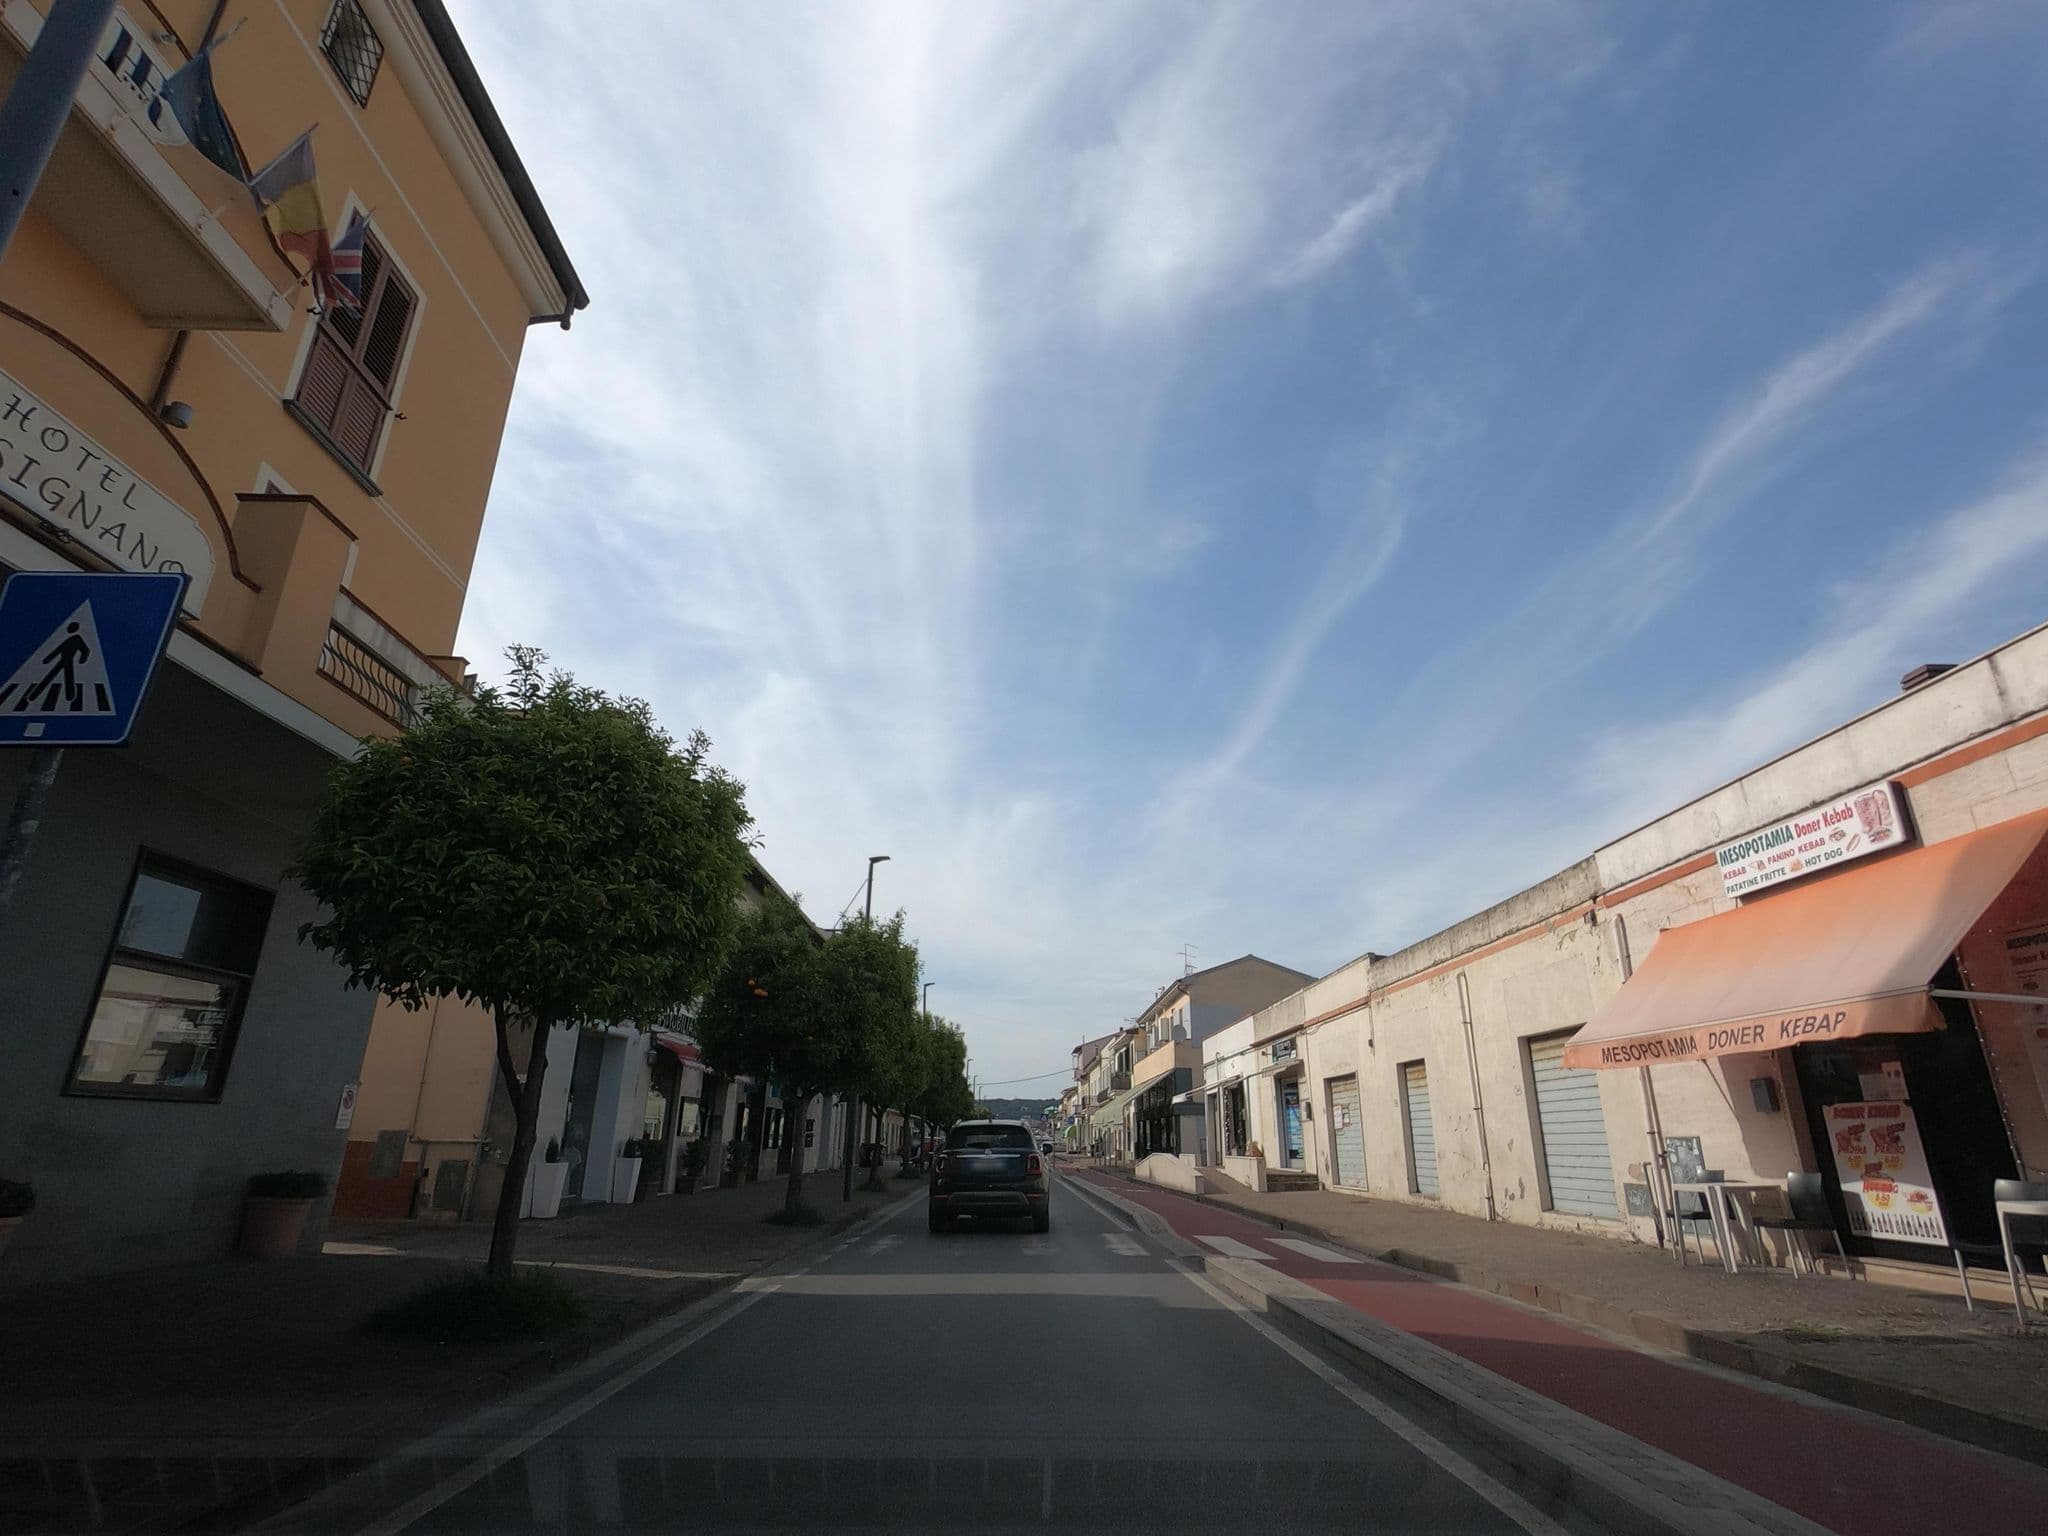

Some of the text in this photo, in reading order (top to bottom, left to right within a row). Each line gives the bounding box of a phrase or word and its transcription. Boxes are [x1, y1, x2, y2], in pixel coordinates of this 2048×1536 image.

[3, 394, 137, 511] HOTEL
[1719, 803, 1853, 867] MESOPOTAMIA Doner Kebab
[1723, 837, 1826, 881] KEBAB PANINO KEBAB
[1726, 847, 1843, 895] PATATINE FRITTE HOT DOG
[1602, 1011, 1847, 1064] MESOPOTAMIA DONER KEBAP
